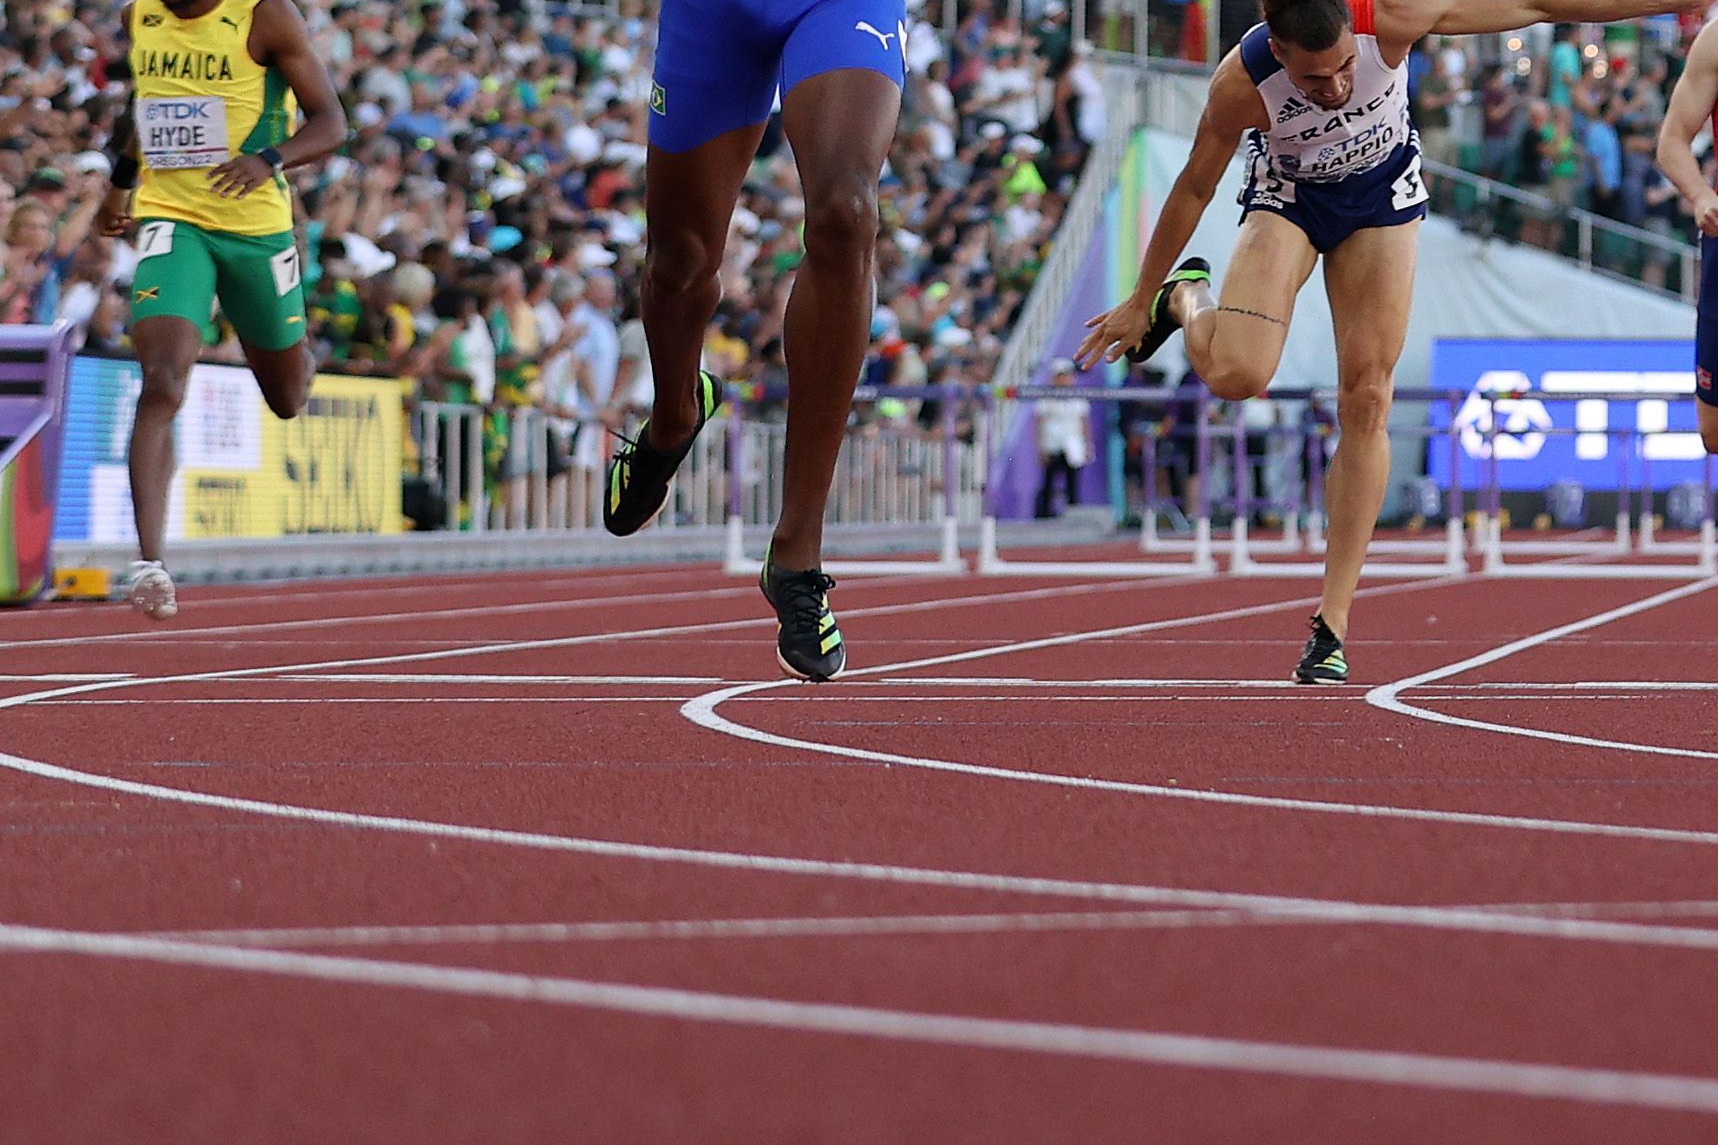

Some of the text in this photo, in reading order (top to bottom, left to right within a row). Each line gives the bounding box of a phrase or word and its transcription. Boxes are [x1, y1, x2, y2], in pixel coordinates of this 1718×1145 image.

[138, 49, 233, 81] JAMAICA
[158, 101, 210, 120] TDK
[150, 124, 206, 148] HYDE
[1334, 116, 1388, 152] TDK
[149, 154, 214, 168] OREGON22
[1312, 126, 1394, 173] HAPPIO
[144, 225, 162, 252] 7
[281, 254, 297, 283] 7
